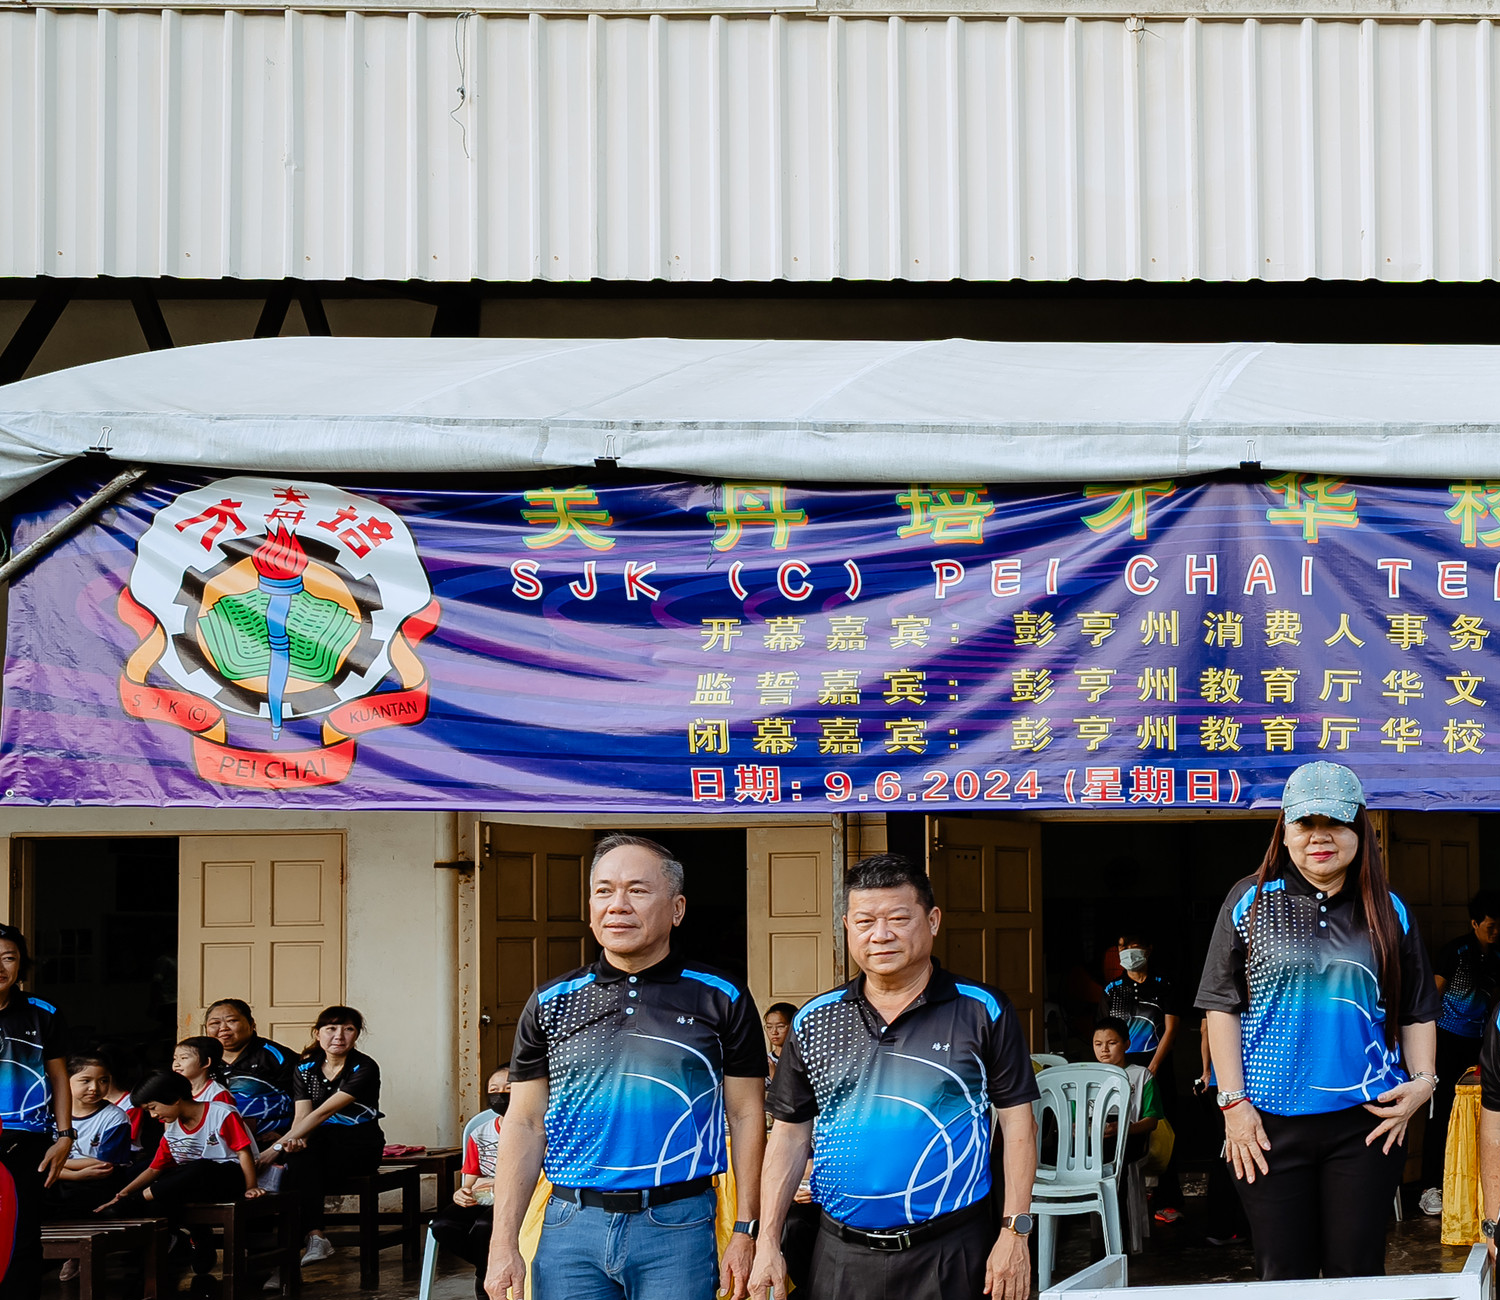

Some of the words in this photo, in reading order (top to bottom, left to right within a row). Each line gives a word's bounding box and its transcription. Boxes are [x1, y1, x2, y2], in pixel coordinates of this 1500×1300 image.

[511, 558, 660, 601] SJK
[728, 558, 862, 601] (C)
[931, 557, 1061, 599] PEI
[1123, 554, 1315, 597] CHAI
[350, 700, 418, 723] KUANTAN
[218, 755, 256, 778] PEI
[264, 757, 327, 780] CHAI
